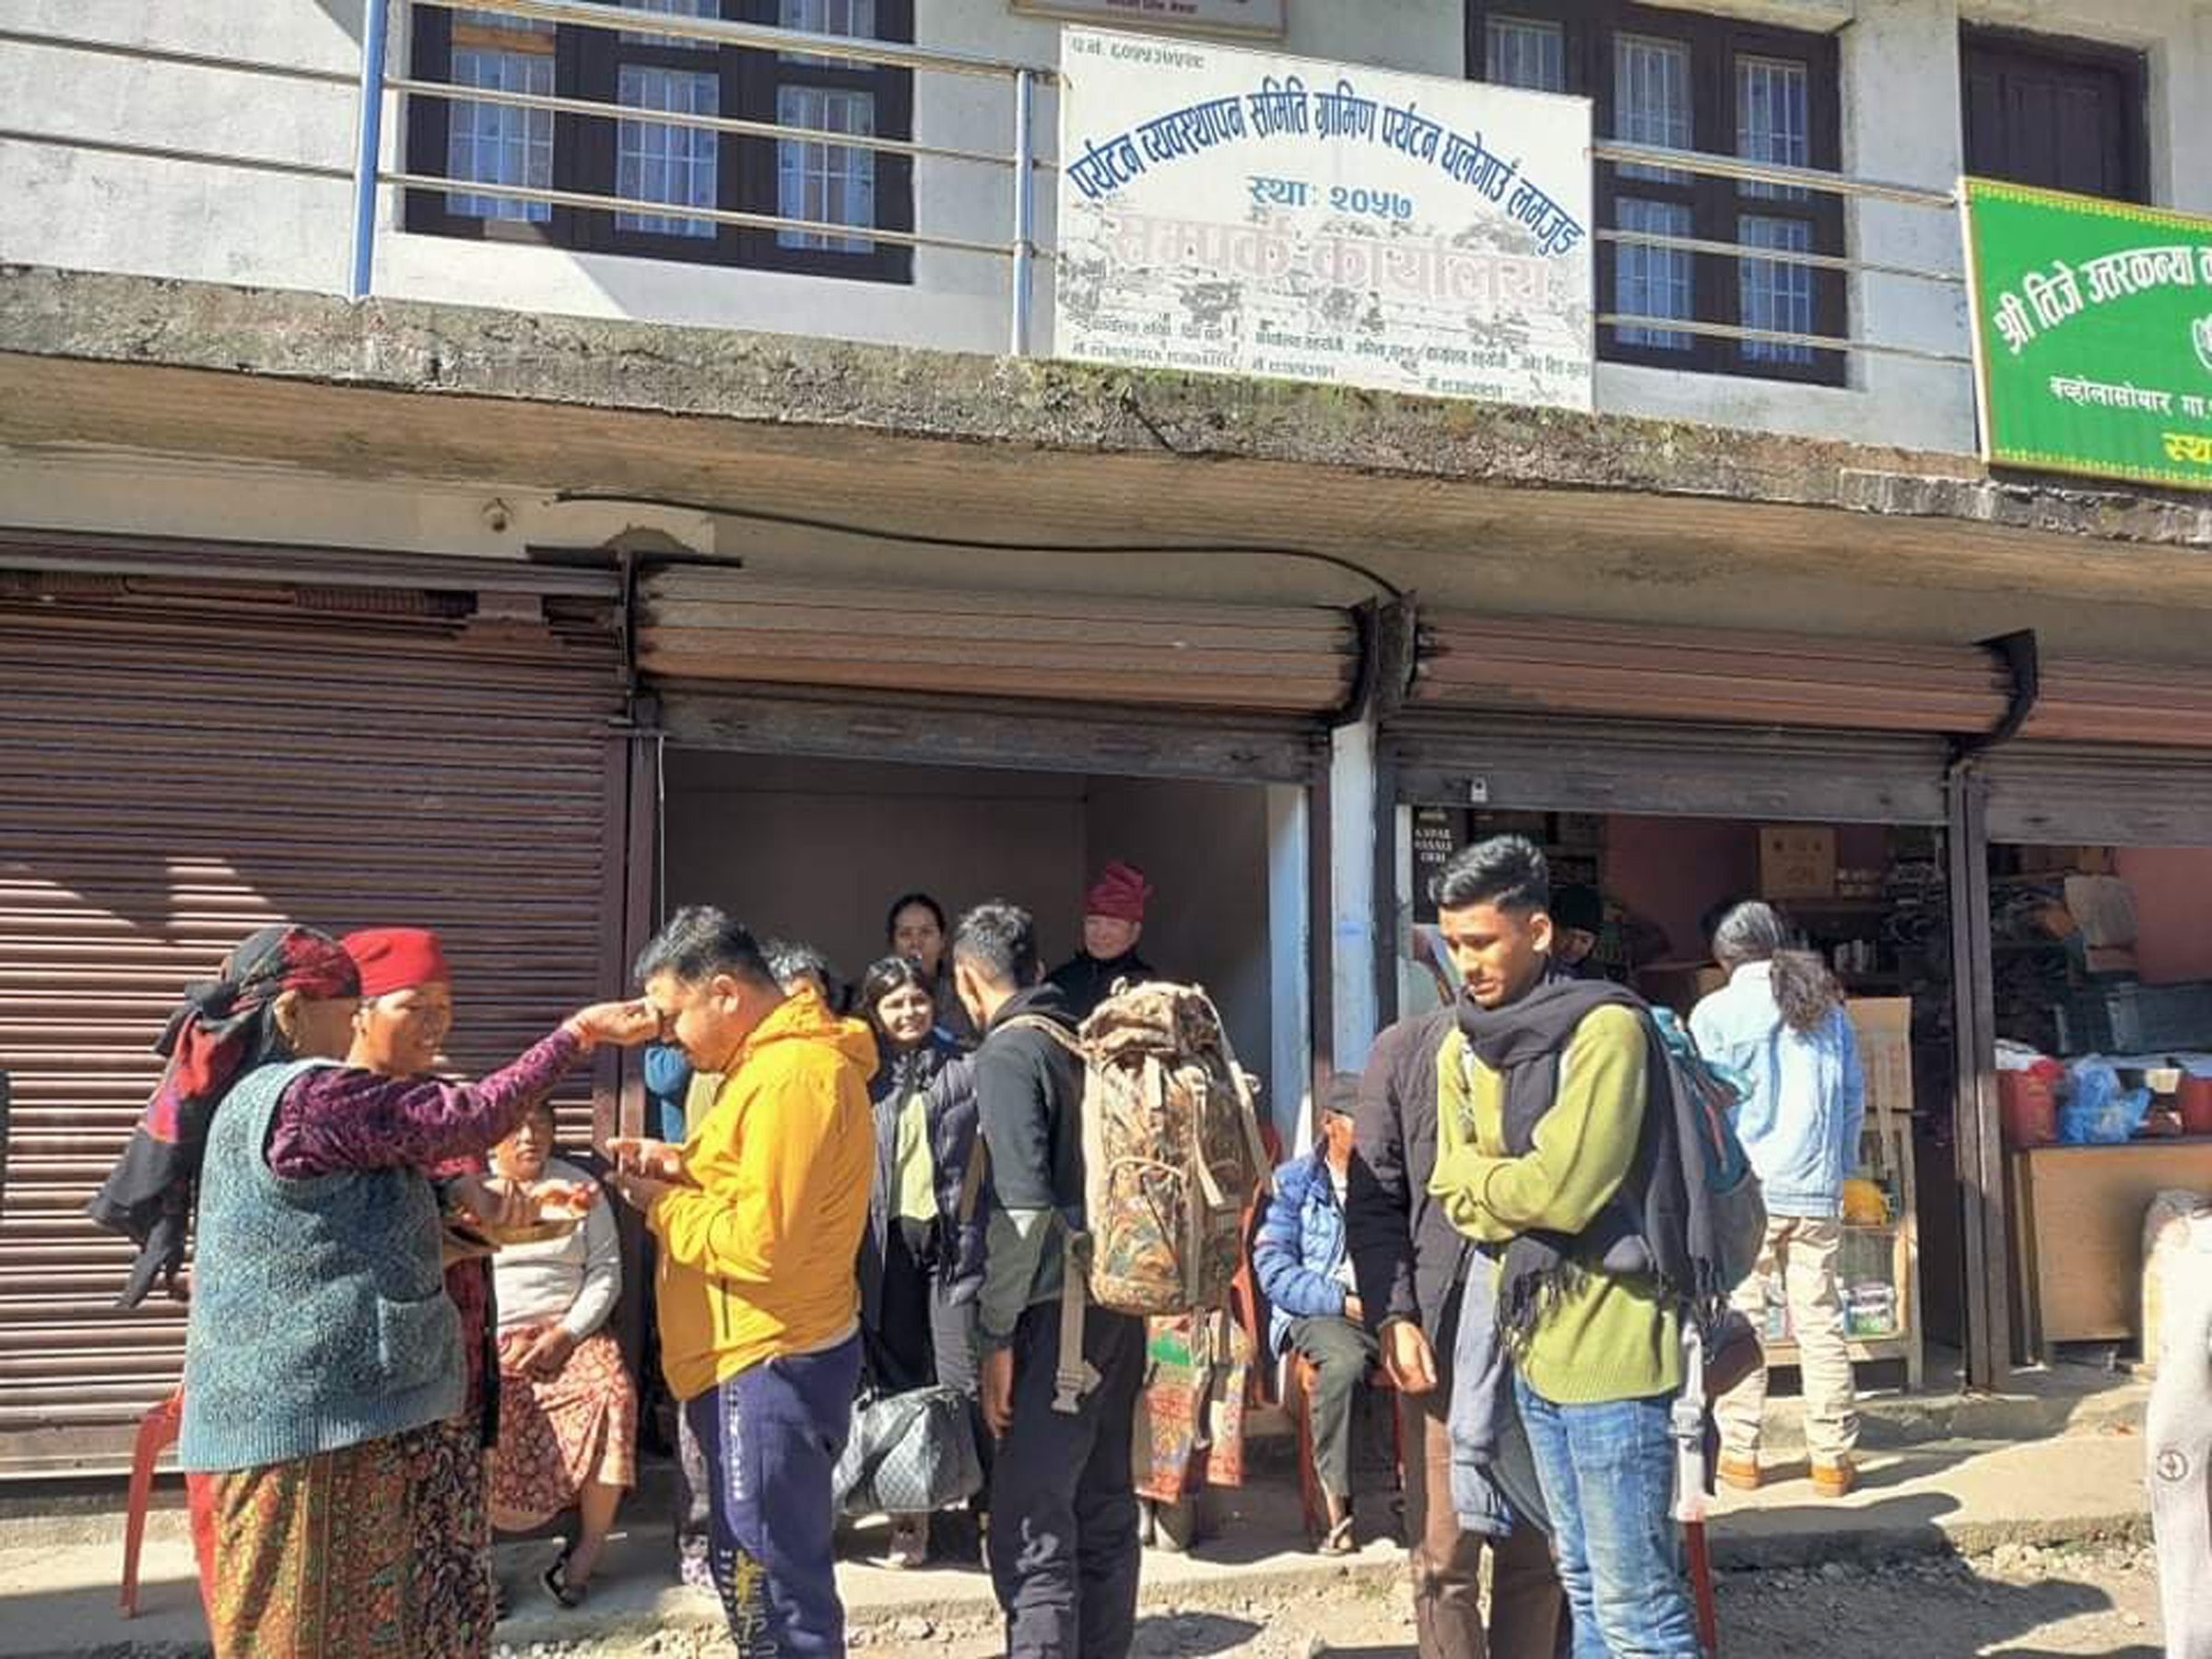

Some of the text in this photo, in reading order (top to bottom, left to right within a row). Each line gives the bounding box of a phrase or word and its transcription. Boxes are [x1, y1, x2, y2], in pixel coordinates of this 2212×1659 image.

[1066, 136, 1147, 199] पर्यटन
[1135, 96, 1246, 162] व्यवस्थापन
[1246, 76, 1309, 138] समिति
[1313, 79, 1377, 142] ग्रामिण
[1382, 102, 1443, 164] पर्यटन
[1507, 177, 1585, 255] लमजुङ
[1330, 186, 1412, 219] २०५७
[1993, 292, 2036, 356] श्री
